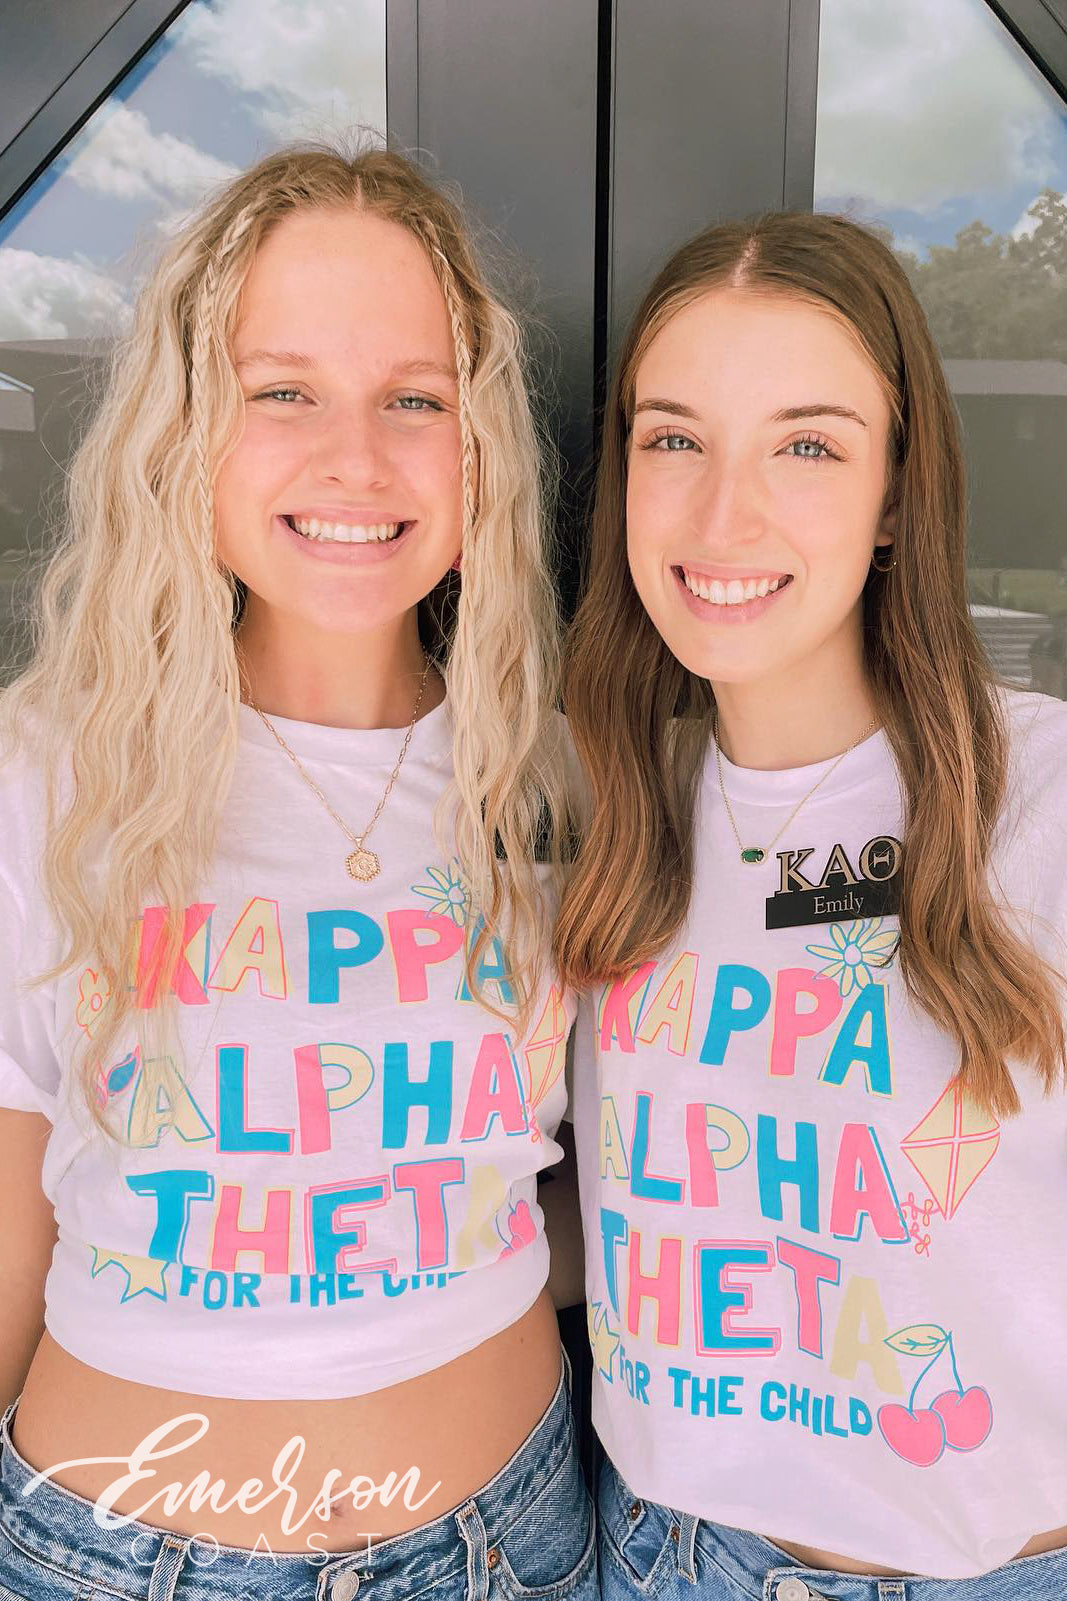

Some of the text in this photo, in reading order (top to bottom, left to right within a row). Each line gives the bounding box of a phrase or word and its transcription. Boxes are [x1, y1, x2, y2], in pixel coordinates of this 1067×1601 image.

[131, 897, 519, 1009] KAPPA
[813, 891, 864, 915] Emily
[598, 952, 894, 1097] KAPPA
[127, 1033, 530, 1155] ALPHA
[126, 1157, 504, 1275] THETA
[601, 1091, 911, 1243] ALPHA
[179, 1265, 262, 1310] FOR
[600, 1207, 906, 1395] THETA
[619, 1344, 873, 1438] FOR THE CHILD
